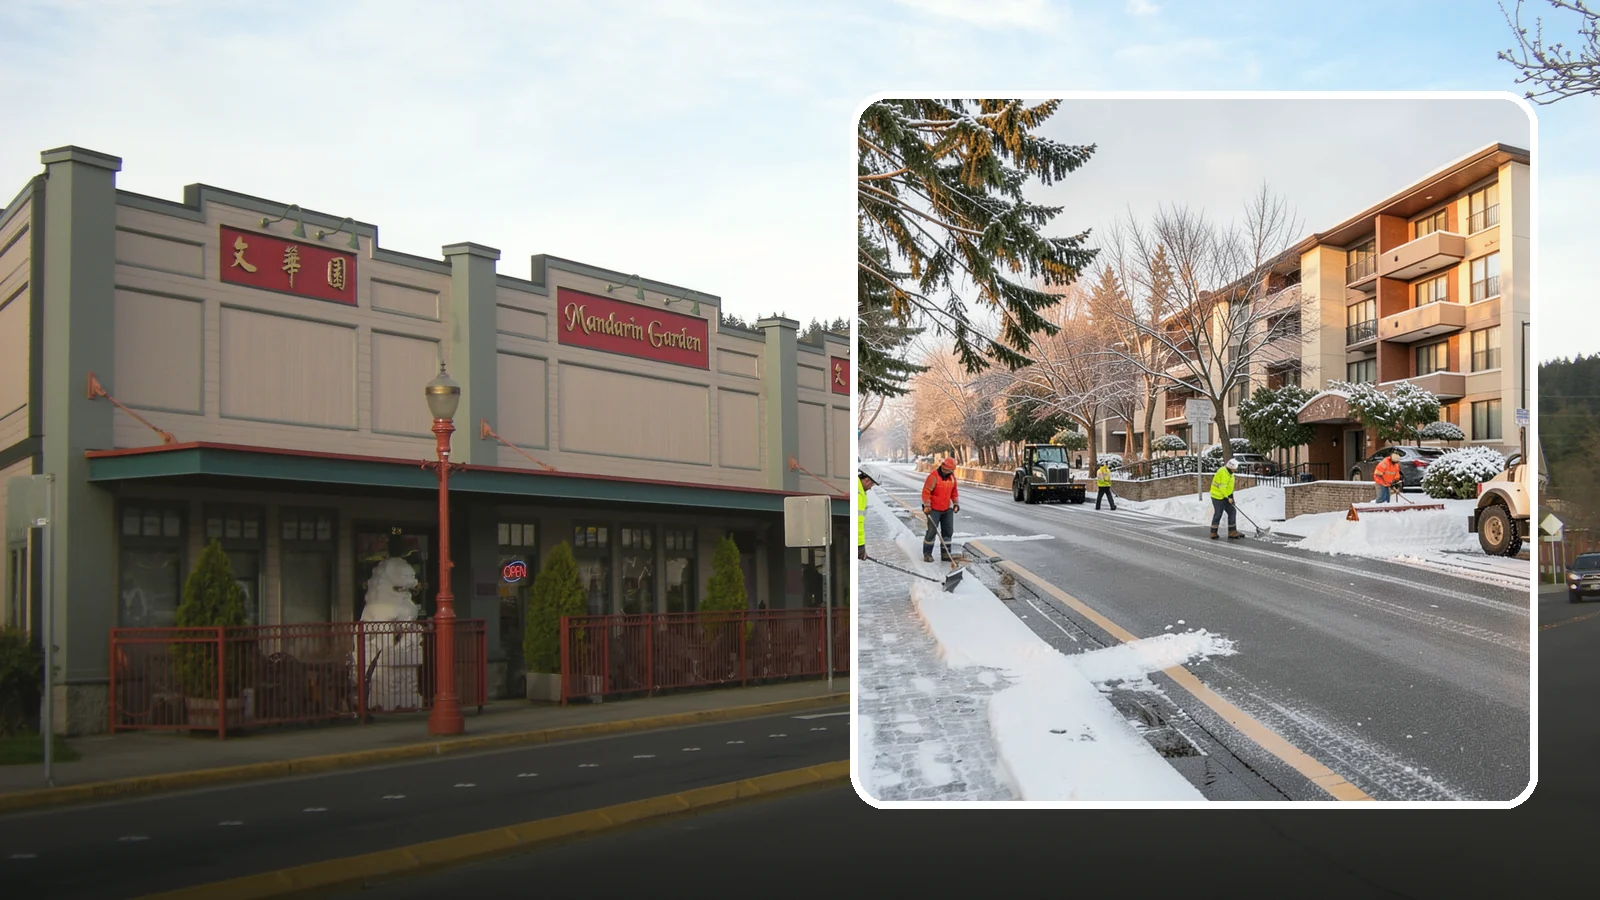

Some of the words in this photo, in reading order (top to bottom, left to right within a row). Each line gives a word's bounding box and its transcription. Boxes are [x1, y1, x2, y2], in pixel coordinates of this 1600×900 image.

[231, 235, 346, 291] 文華園
[564, 302, 644, 341] Mandarin
[647, 320, 701, 352] Garden
[503, 565, 527, 578] OPEN
